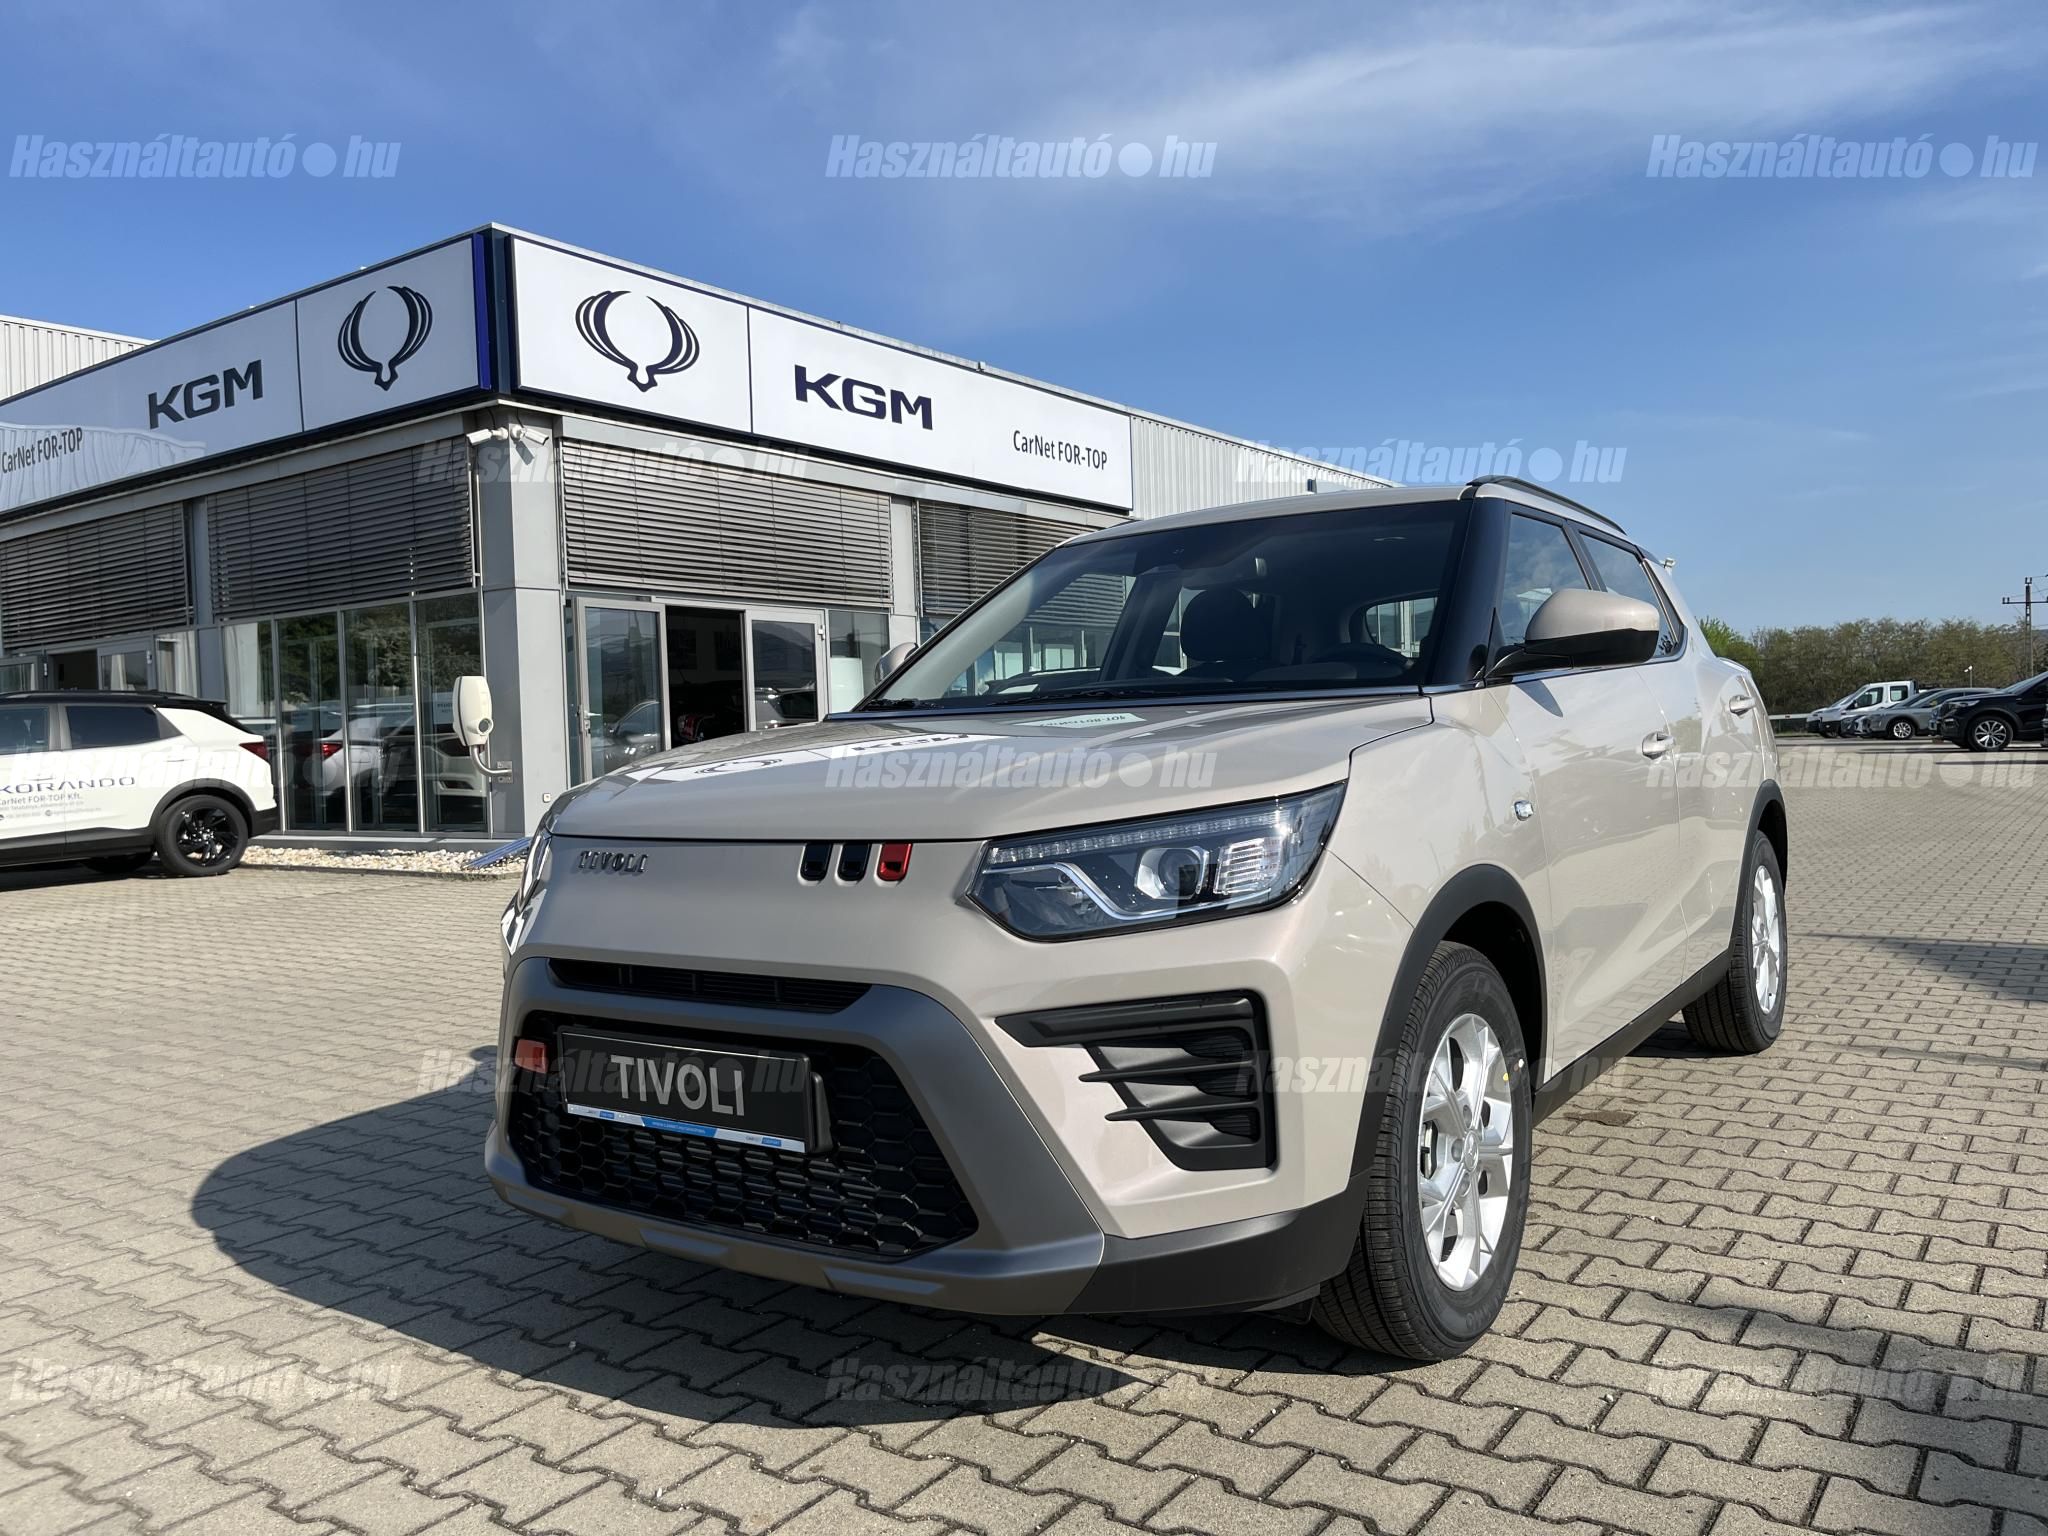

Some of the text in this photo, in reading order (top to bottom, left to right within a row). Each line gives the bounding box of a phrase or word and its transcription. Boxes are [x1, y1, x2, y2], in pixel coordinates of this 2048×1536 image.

[148, 359, 263, 430] KGM
[794, 364, 933, 430] KGM
[2, 427, 83, 474] CarNet FOR-TOP
[1013, 430, 1107, 470] CarNet FOR-TOP
[0, 797, 26, 807] arNet
[579, 850, 649, 873] TIVOLI
[610, 1054, 745, 1117] TIVOLI
